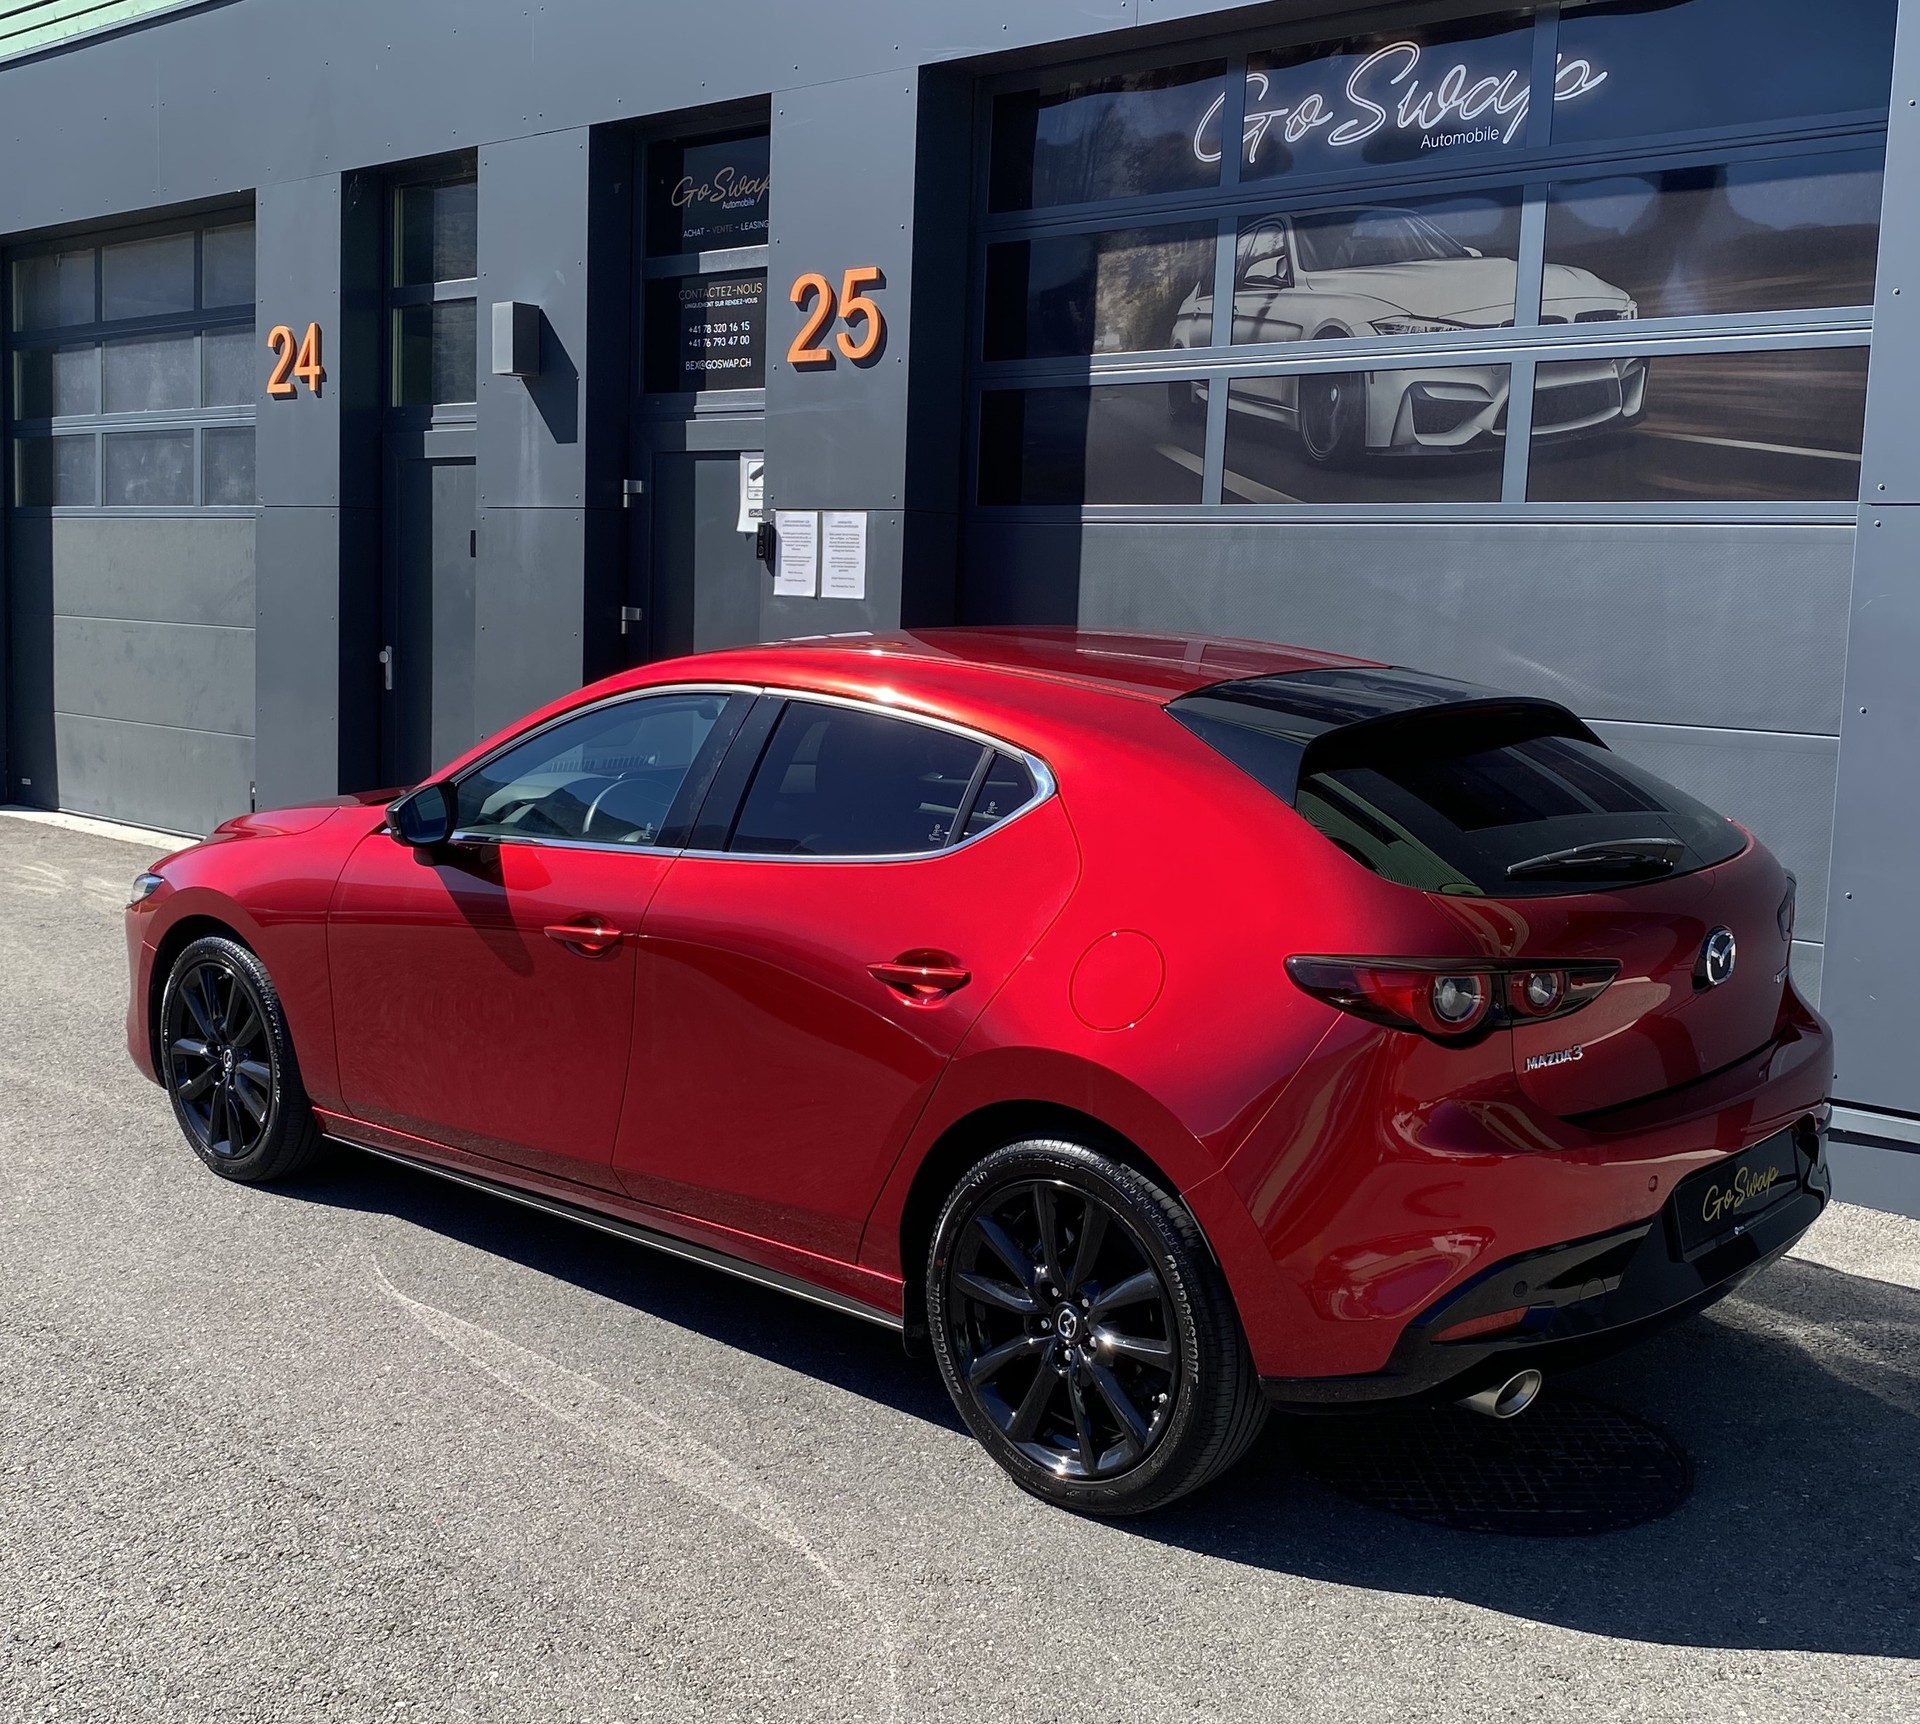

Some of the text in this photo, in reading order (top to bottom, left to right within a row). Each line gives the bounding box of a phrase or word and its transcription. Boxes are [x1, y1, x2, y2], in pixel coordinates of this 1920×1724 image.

[1420, 126, 1500, 149] Automobile
[722, 197, 755, 209] Automobile
[683, 227, 704, 238] ACHAT
[712, 224, 733, 234] VENTE
[740, 219, 769, 231] LEASING
[679, 282, 763, 300] CONTACTEZ-NOUS
[725, 297, 758, 306] RENDEZ-VOUS
[786, 265, 883, 363] 25
[688, 321, 750, 334] +41 78 320 16 15
[688, 335, 750, 348] +41 76 793 47 00
[266, 321, 321, 394] 24
